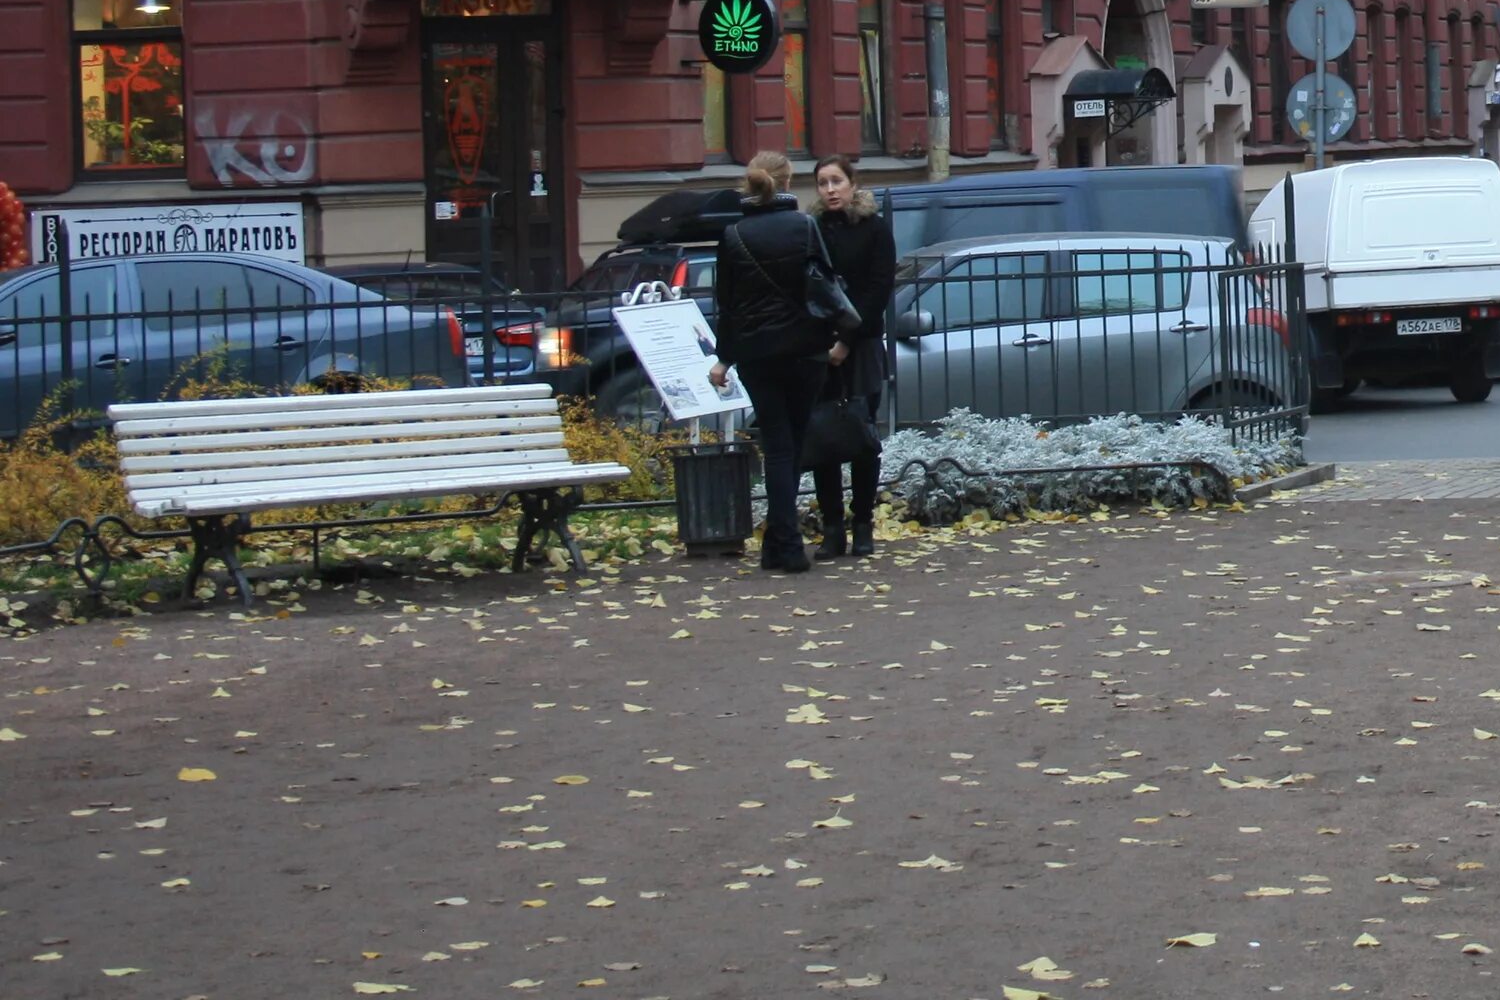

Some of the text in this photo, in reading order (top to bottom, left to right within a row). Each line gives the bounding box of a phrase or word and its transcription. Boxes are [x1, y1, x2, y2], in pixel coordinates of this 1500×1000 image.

[714, 40, 759, 52] ETHNO
[1075, 102, 1104, 111] ОТЕЛЬ
[79, 225, 297, 257] РЕСТОРАН ПАРАТОВЪ
